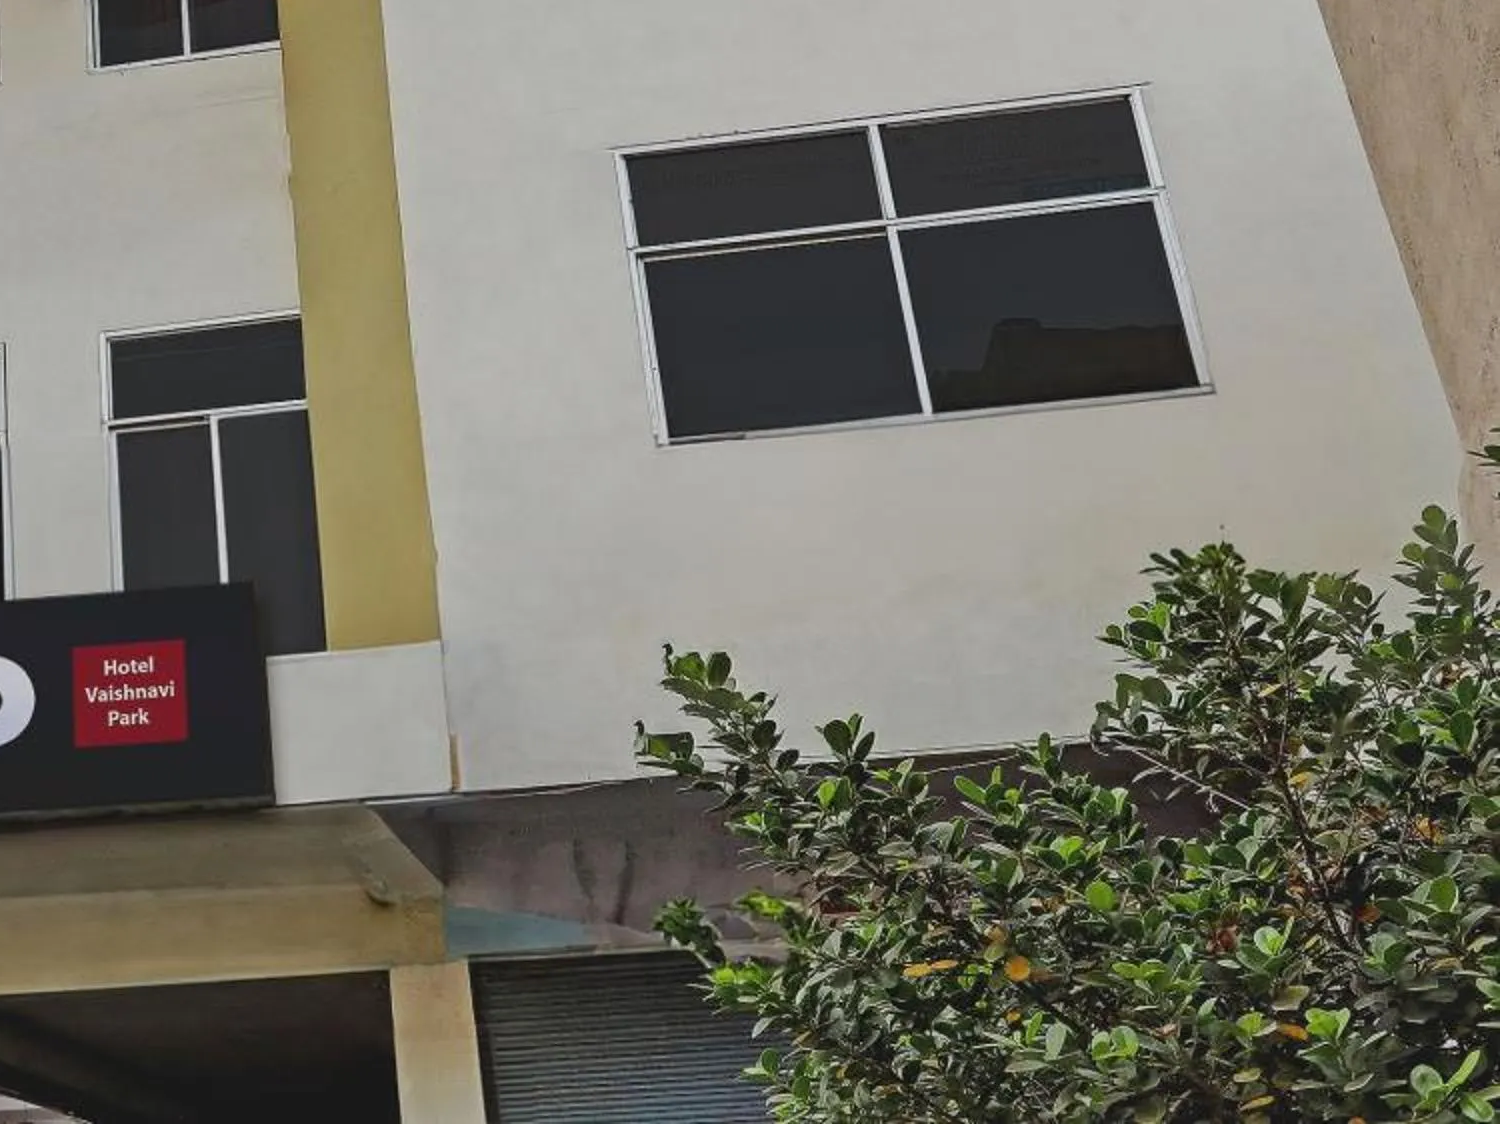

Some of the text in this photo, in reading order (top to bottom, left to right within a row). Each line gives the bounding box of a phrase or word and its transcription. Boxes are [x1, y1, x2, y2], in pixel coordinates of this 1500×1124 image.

[103, 655, 154, 676] Hotel
[84, 679, 175, 703] Vaishnavi
[107, 707, 150, 726] Park
